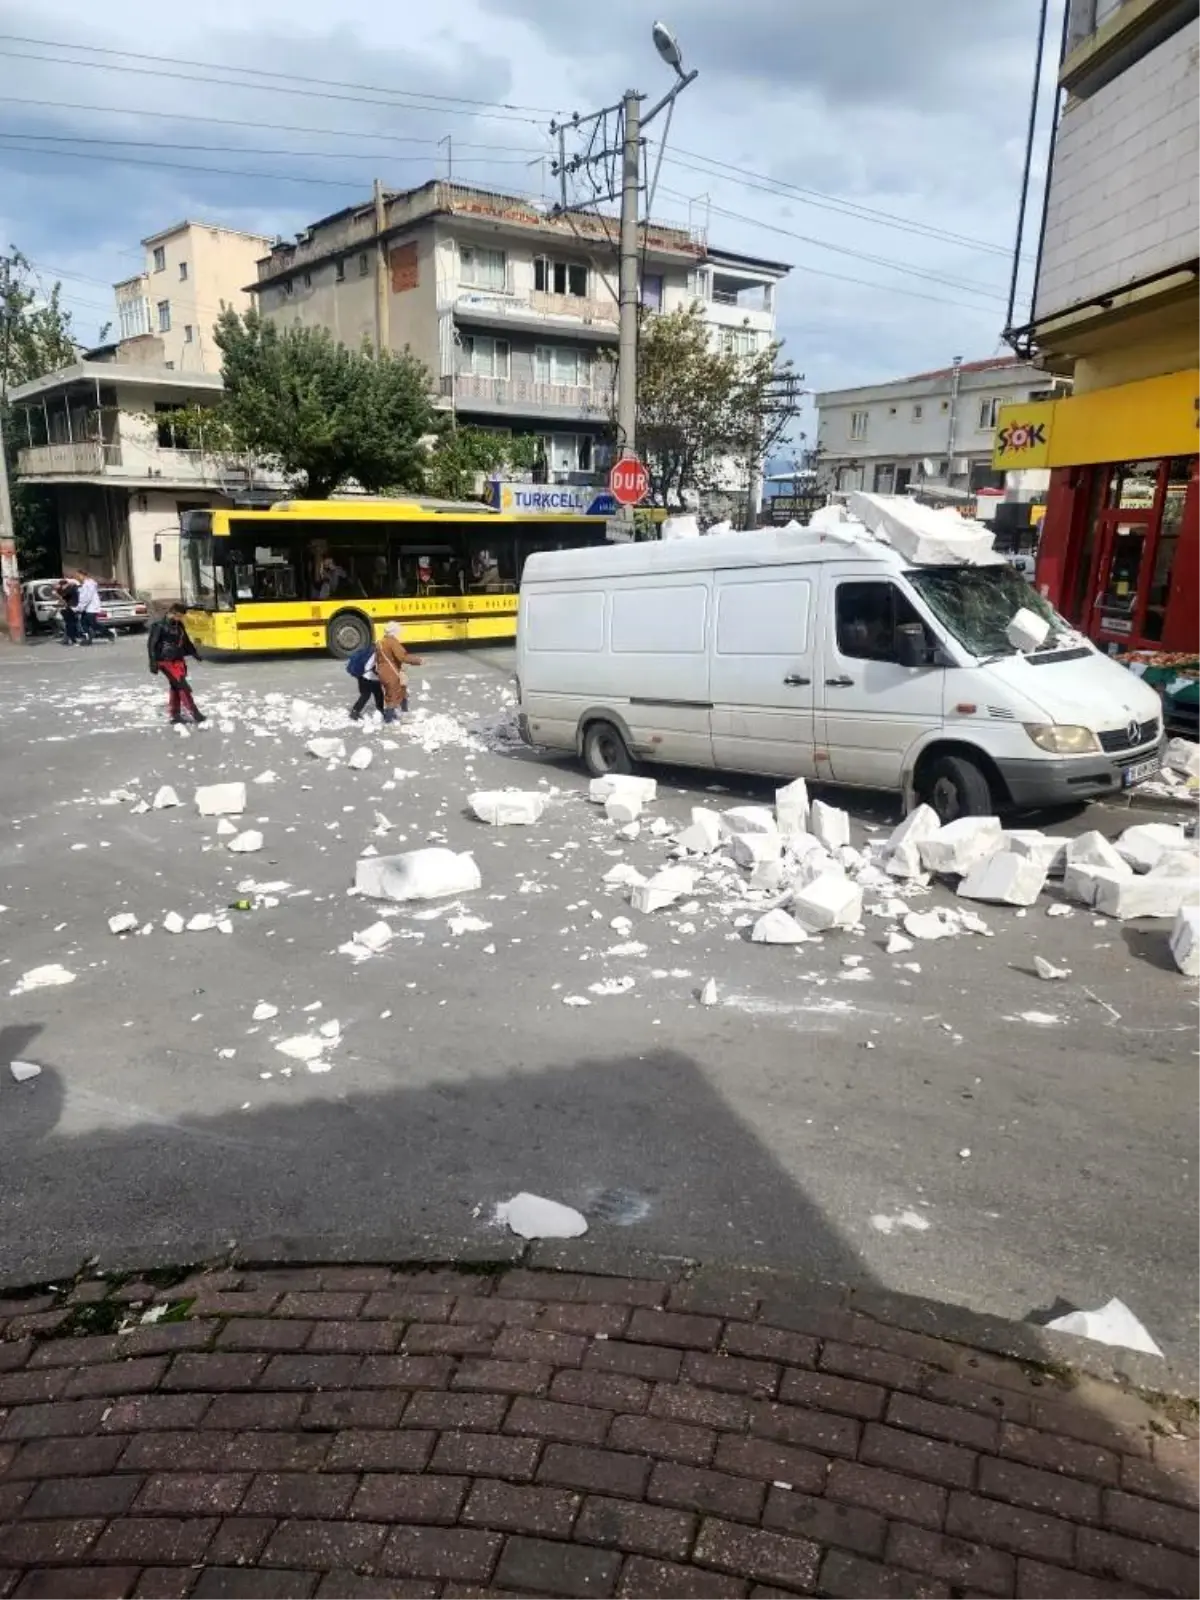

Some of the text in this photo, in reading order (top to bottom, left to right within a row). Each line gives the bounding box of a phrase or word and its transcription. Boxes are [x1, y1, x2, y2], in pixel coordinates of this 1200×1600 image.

[998, 423, 1046, 456] ŞOK
[613, 472, 645, 490] DUR
[514, 491, 583, 508] TURKCELL
